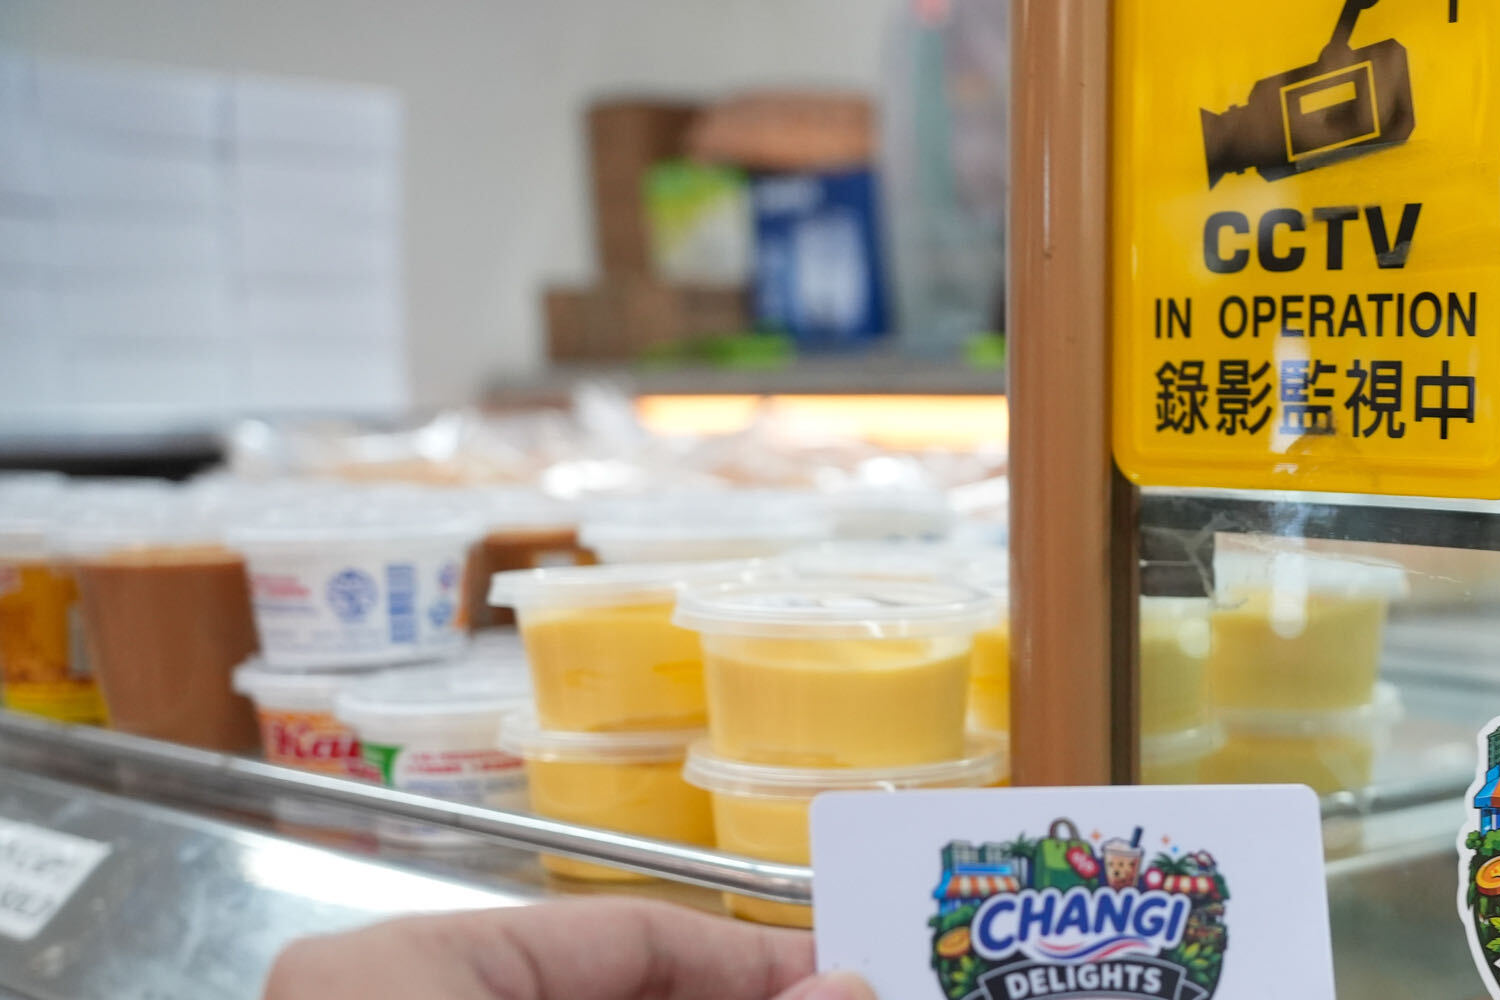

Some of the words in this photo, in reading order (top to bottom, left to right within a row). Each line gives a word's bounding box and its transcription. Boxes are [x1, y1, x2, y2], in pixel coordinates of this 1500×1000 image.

[1203, 203, 1423, 274] CCTV
[1155, 298, 1192, 338] IN
[1218, 291, 1478, 339] OPERATION
[1155, 358, 1476, 441] 錄影監視中
[978, 893, 1186, 952] CHANGI
[1006, 963, 1162, 999] DELIGHTS
